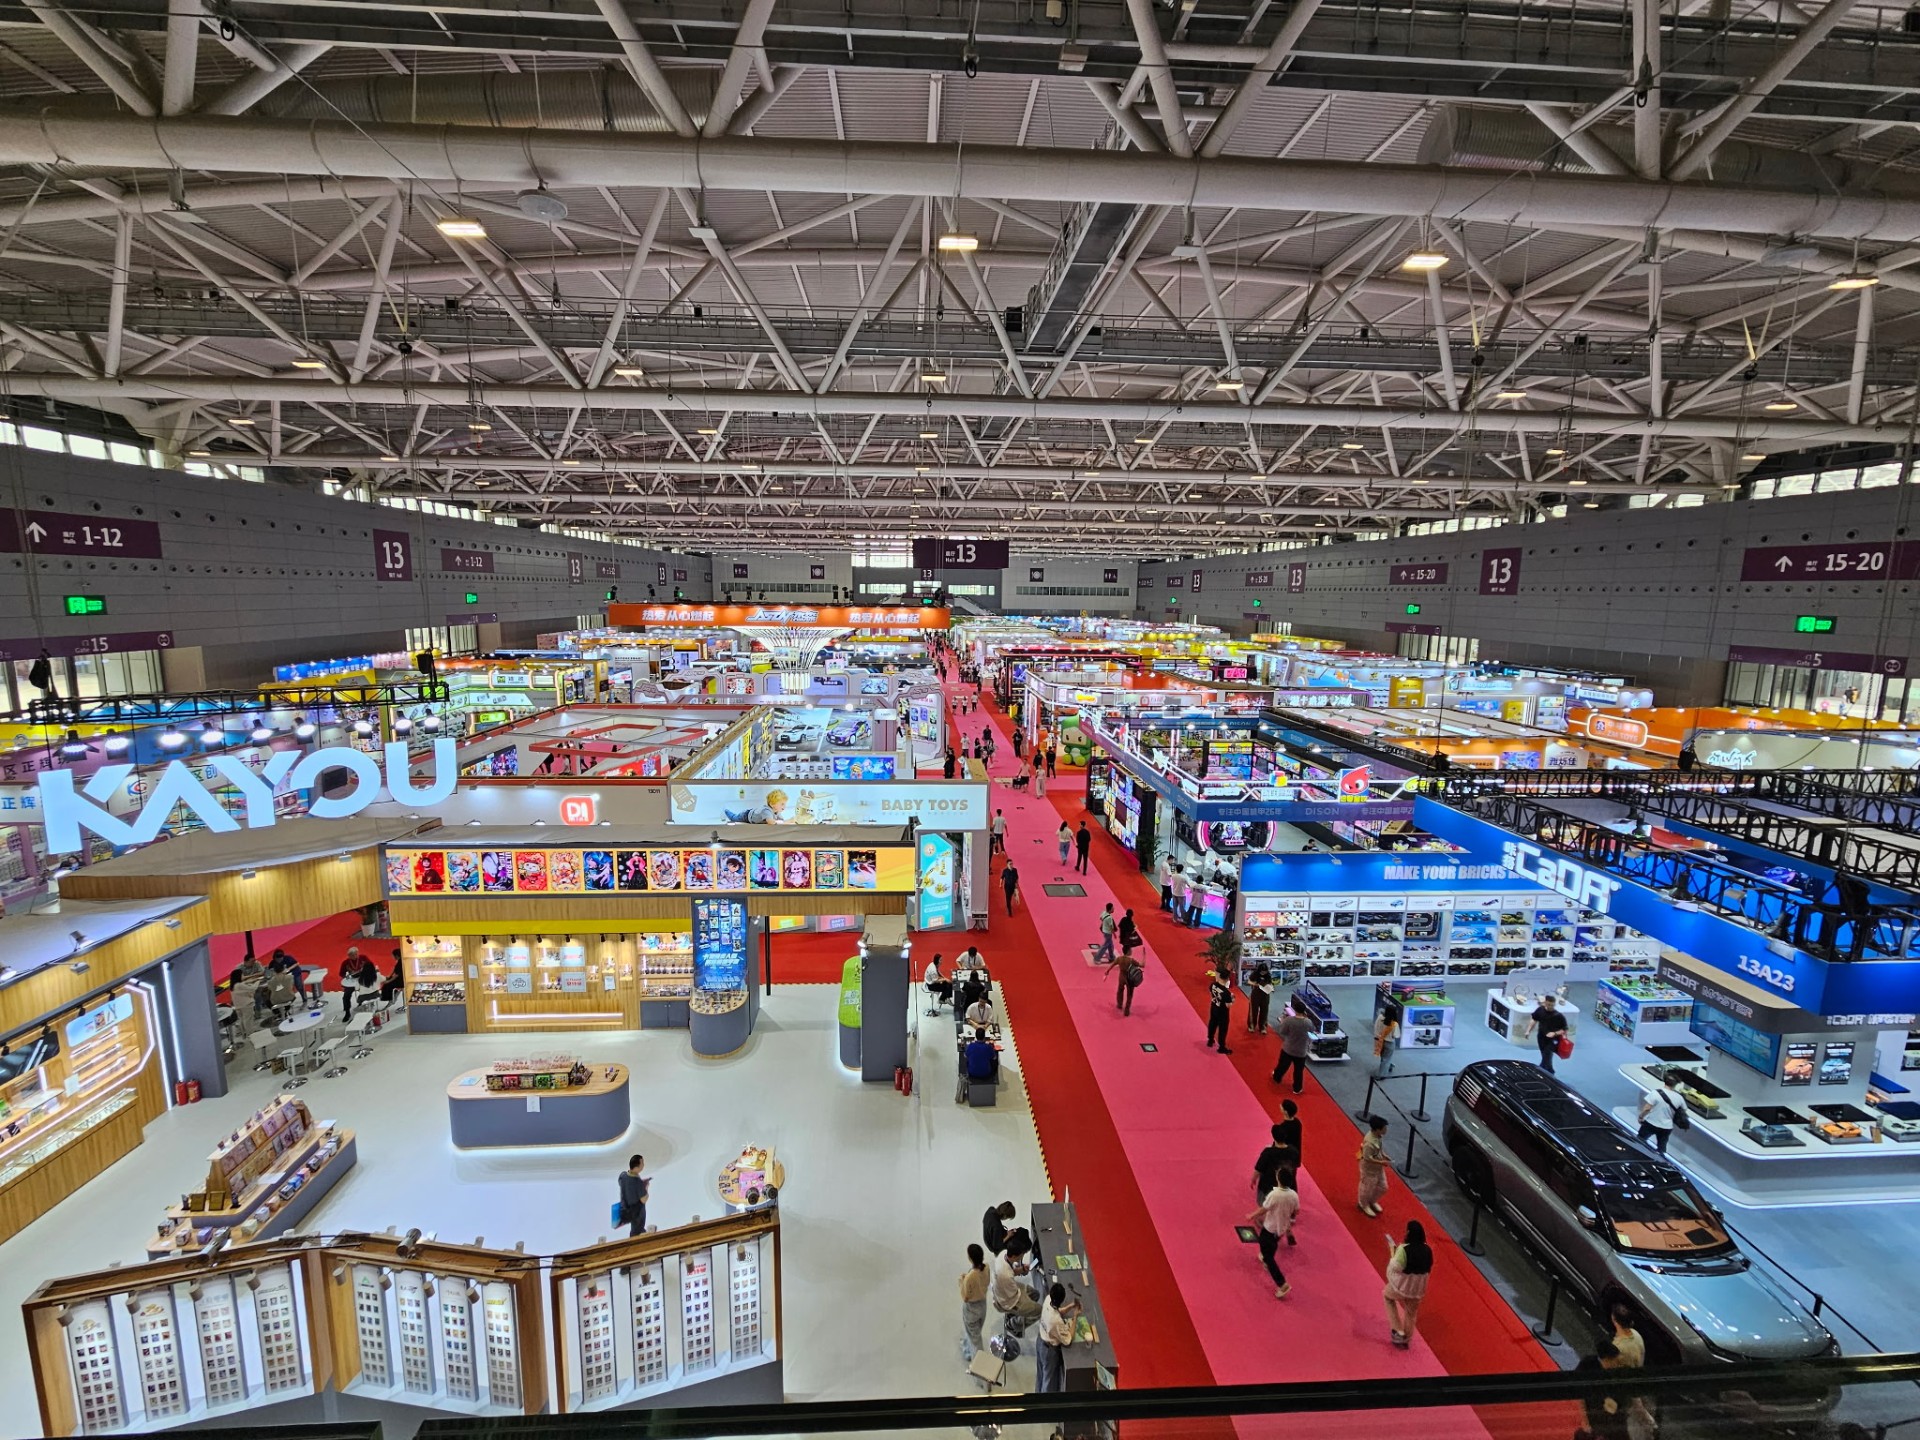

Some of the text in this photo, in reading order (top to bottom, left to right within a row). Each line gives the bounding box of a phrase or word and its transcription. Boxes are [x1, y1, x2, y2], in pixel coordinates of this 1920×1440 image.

[82, 526, 123, 547] 1-12
[382, 541, 404, 569] 13
[956, 543, 976, 563] 13
[470, 556, 483, 568] 1-12
[571, 558, 581, 577] 13
[1824, 552, 1884, 572] 15-20
[659, 567, 665, 580] 13
[922, 569, 932, 578] 13
[1292, 569, 1302, 586] 13
[1416, 569, 1436, 580] 15-20
[1488, 558, 1512, 584] 13
[1193, 574, 1200, 588] 13
[91, 637, 109, 652] 15
[1796, 659, 1811, 667] Gate
[1812, 653, 1822, 666] 5
[38, 737, 457, 855] KAYOU
[881, 799, 969, 811] BABY TOYS
[1305, 807, 1340, 816] DISON
[1383, 865, 1420, 880] MAKE
[1422, 865, 1457, 880] YOUR
[1458, 865, 1506, 880] BRICKS
[1516, 841, 1611, 914] CaDA
[1737, 955, 1795, 992] 13A23
